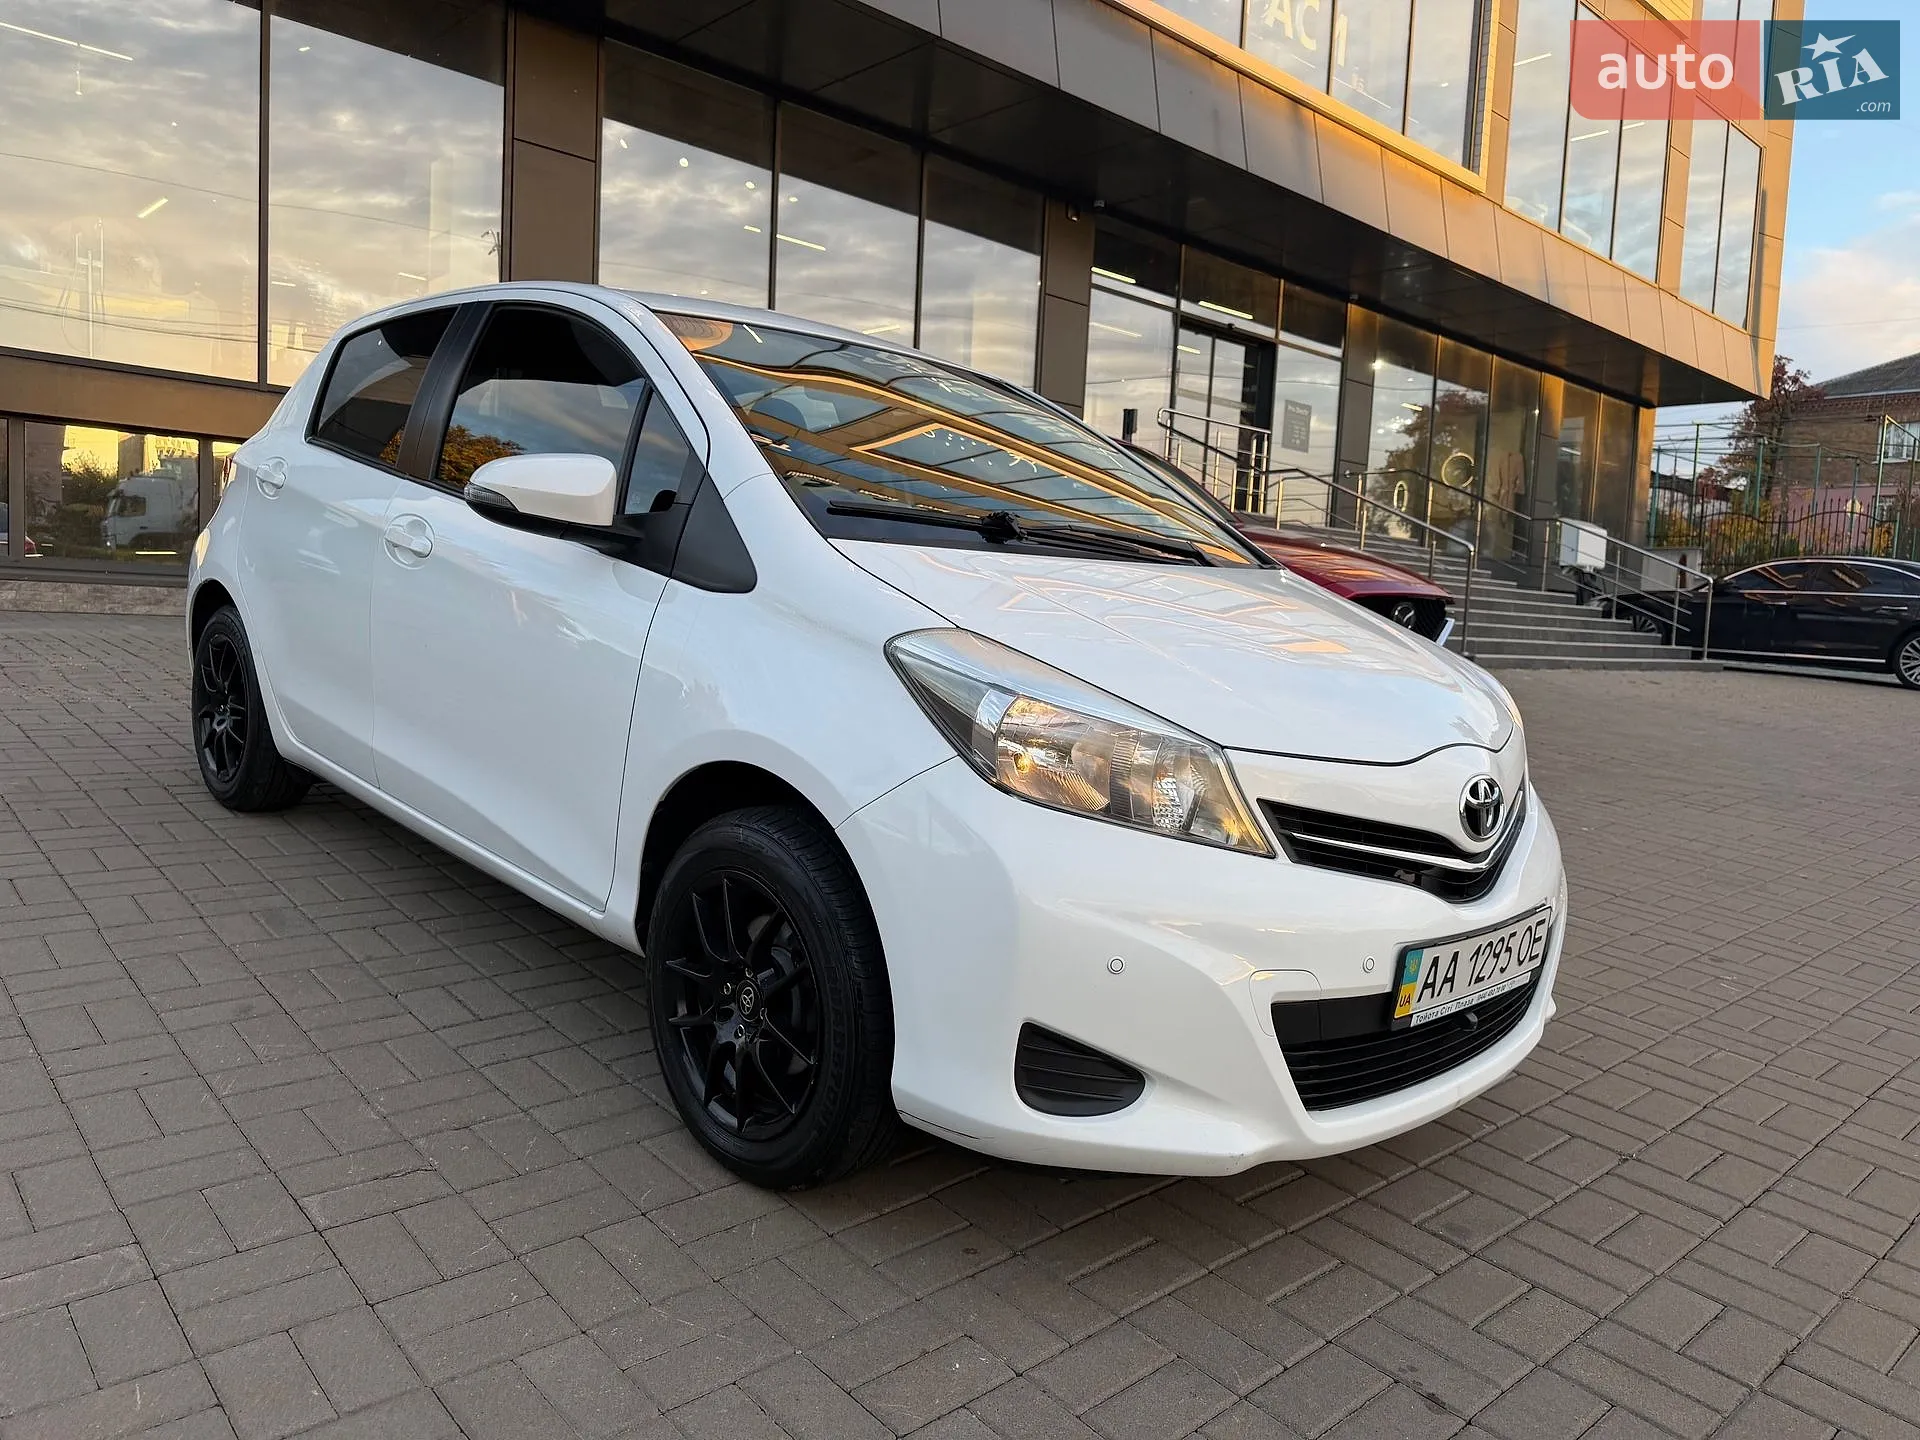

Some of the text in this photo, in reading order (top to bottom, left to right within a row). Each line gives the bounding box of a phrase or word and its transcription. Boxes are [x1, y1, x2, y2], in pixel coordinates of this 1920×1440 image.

[1416, 950, 1460, 1004] AA
[1468, 930, 1518, 987] 1295
[1517, 918, 1547, 968] OE
[1399, 993, 1412, 1008] UA
